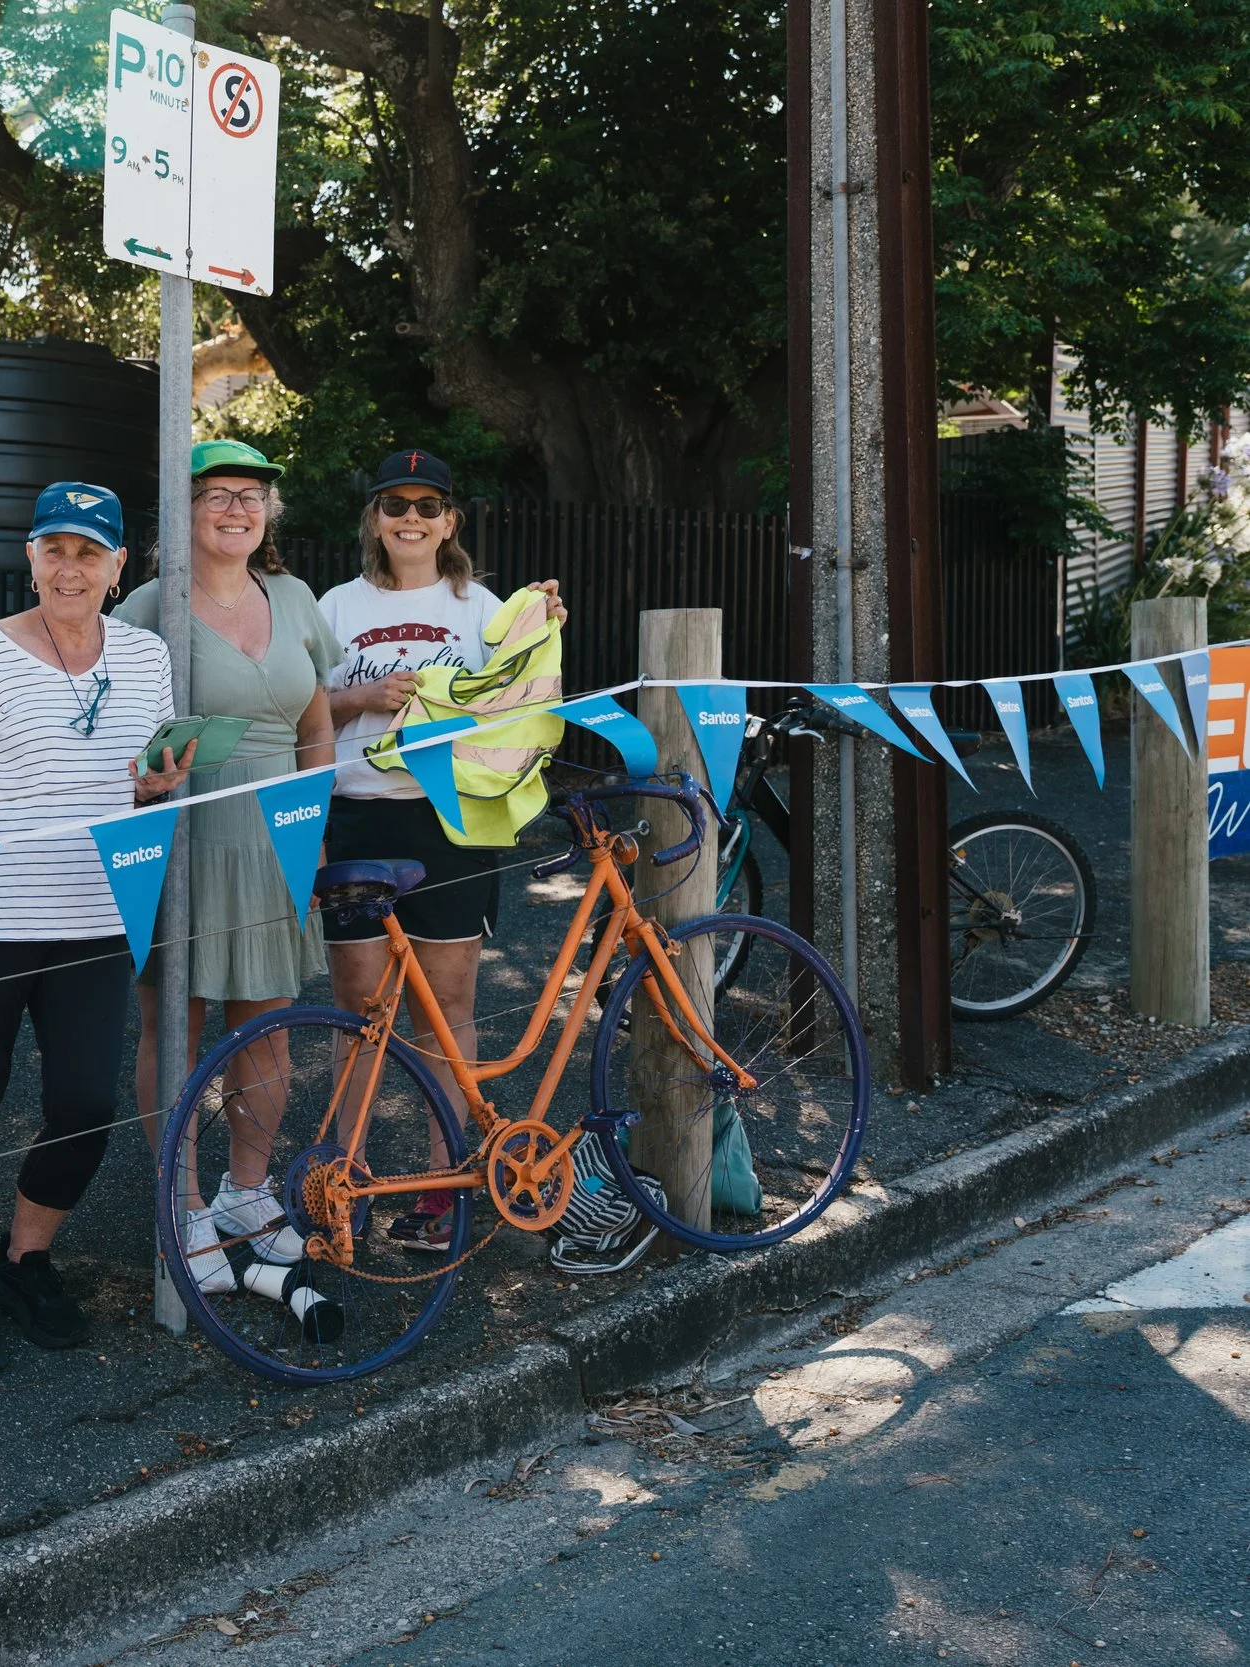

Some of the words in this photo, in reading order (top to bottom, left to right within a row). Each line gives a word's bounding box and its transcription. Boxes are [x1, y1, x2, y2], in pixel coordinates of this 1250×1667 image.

[114, 32, 146, 89] P
[156, 49, 185, 88] 10
[150, 90, 187, 112] MINUTE
[111, 136, 127, 164] 9
[127, 159, 141, 172] AM
[155, 149, 169, 178] 5
[172, 173, 184, 185] PM
[361, 627, 440, 644] HAPPY
[1139, 682, 1164, 694] Santos
[1187, 674, 1208, 687] Santos
[831, 695, 869, 707] Santos
[997, 701, 1021, 713] Santos
[1066, 695, 1095, 709] Santos
[580, 711, 625, 726] Santos
[698, 711, 741, 726] Santos
[903, 706, 934, 718] Santos
[274, 804, 322, 828] Santos
[111, 844, 163, 869] Santos
